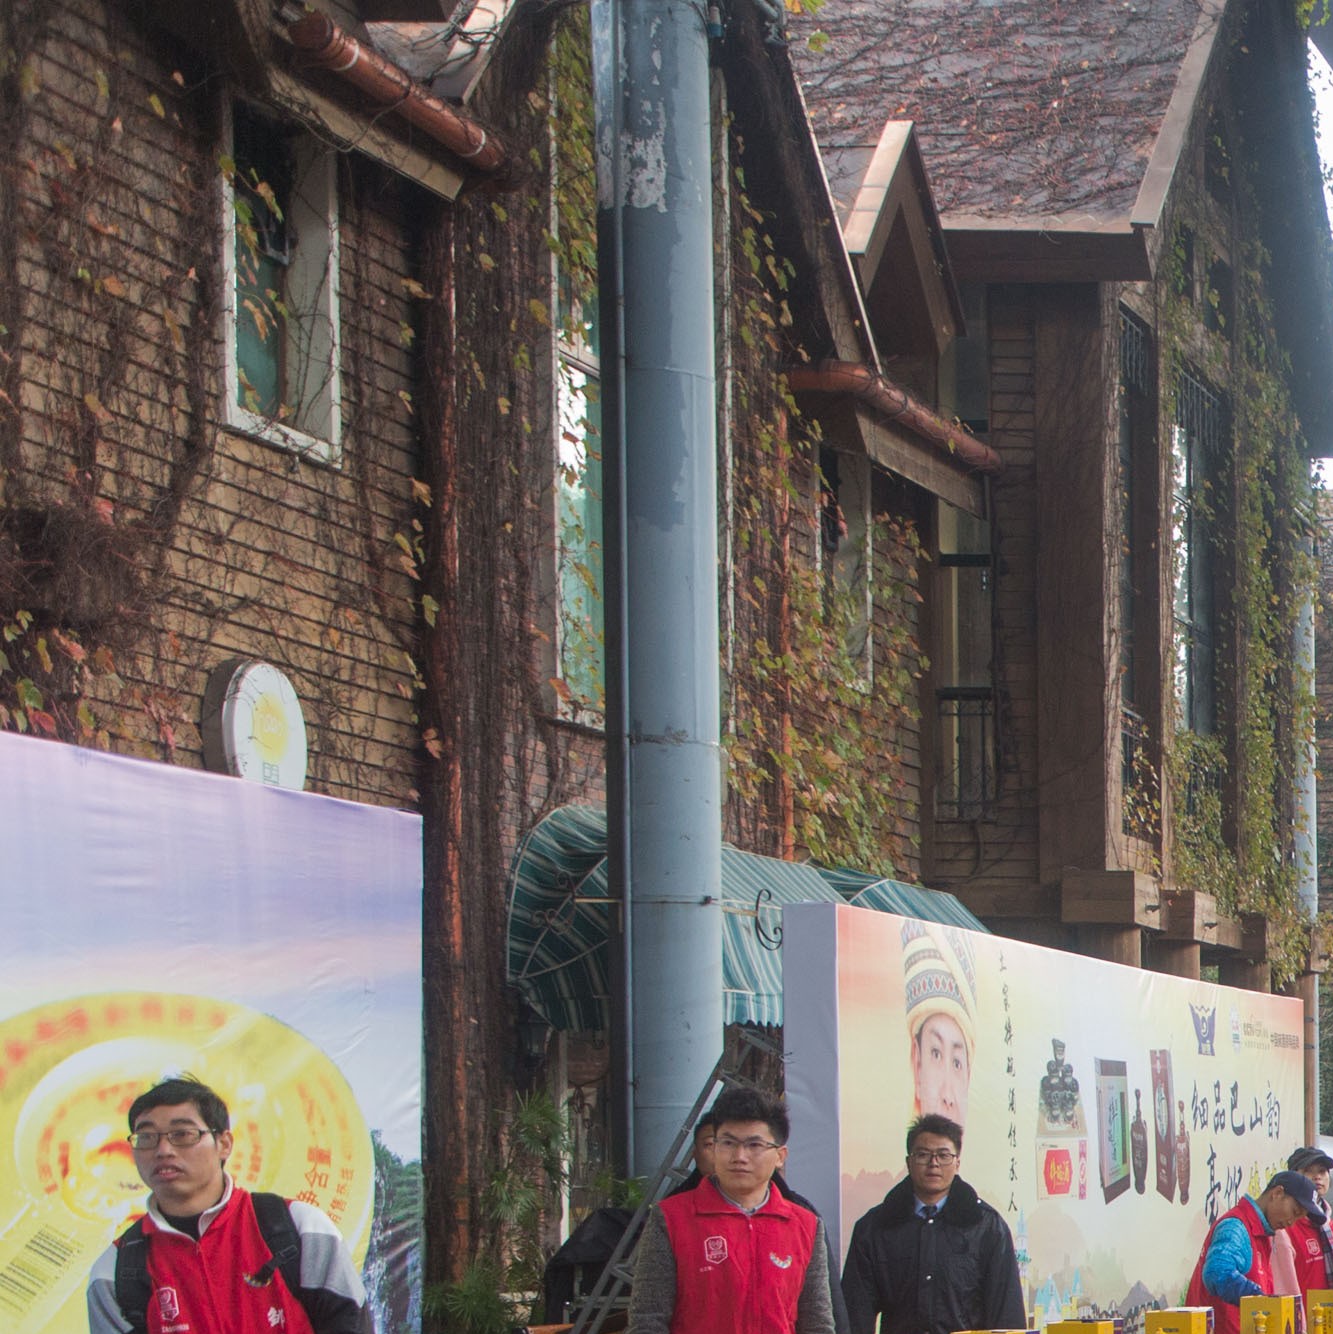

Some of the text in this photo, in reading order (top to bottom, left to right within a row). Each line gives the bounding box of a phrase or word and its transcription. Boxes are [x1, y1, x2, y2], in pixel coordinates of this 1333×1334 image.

[1191, 1079, 1281, 1141] 细品巴山韵
